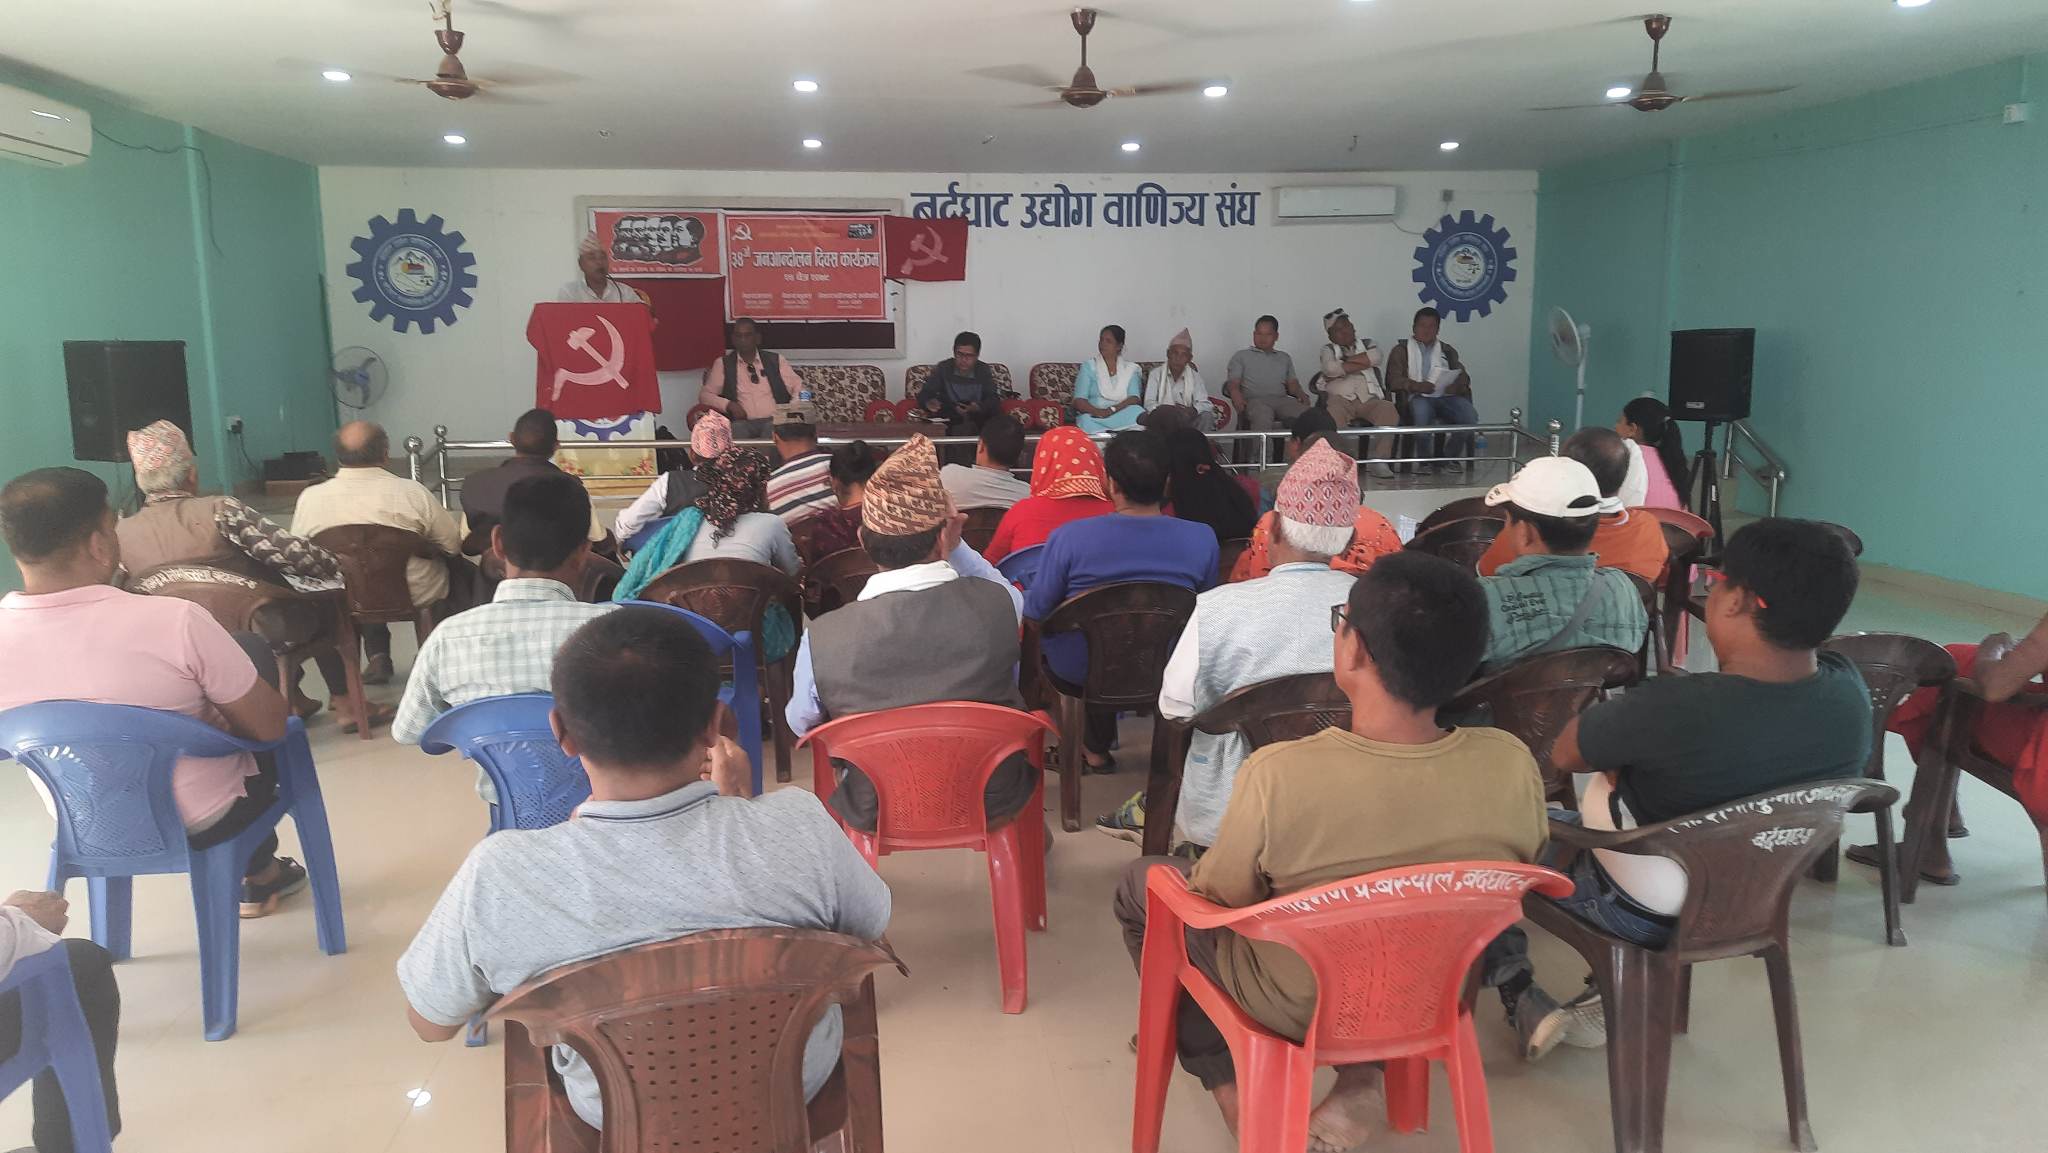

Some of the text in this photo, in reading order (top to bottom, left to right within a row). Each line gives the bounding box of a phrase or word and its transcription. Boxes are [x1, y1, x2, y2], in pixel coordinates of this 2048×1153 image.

[1020, 183, 1097, 228] उद्योग
[1103, 182, 1209, 227] वाणिज्य
[1214, 182, 1261, 227] संघ
[814, 246, 838, 268] दिवस
[840, 247, 880, 268] कार्यक्रम
